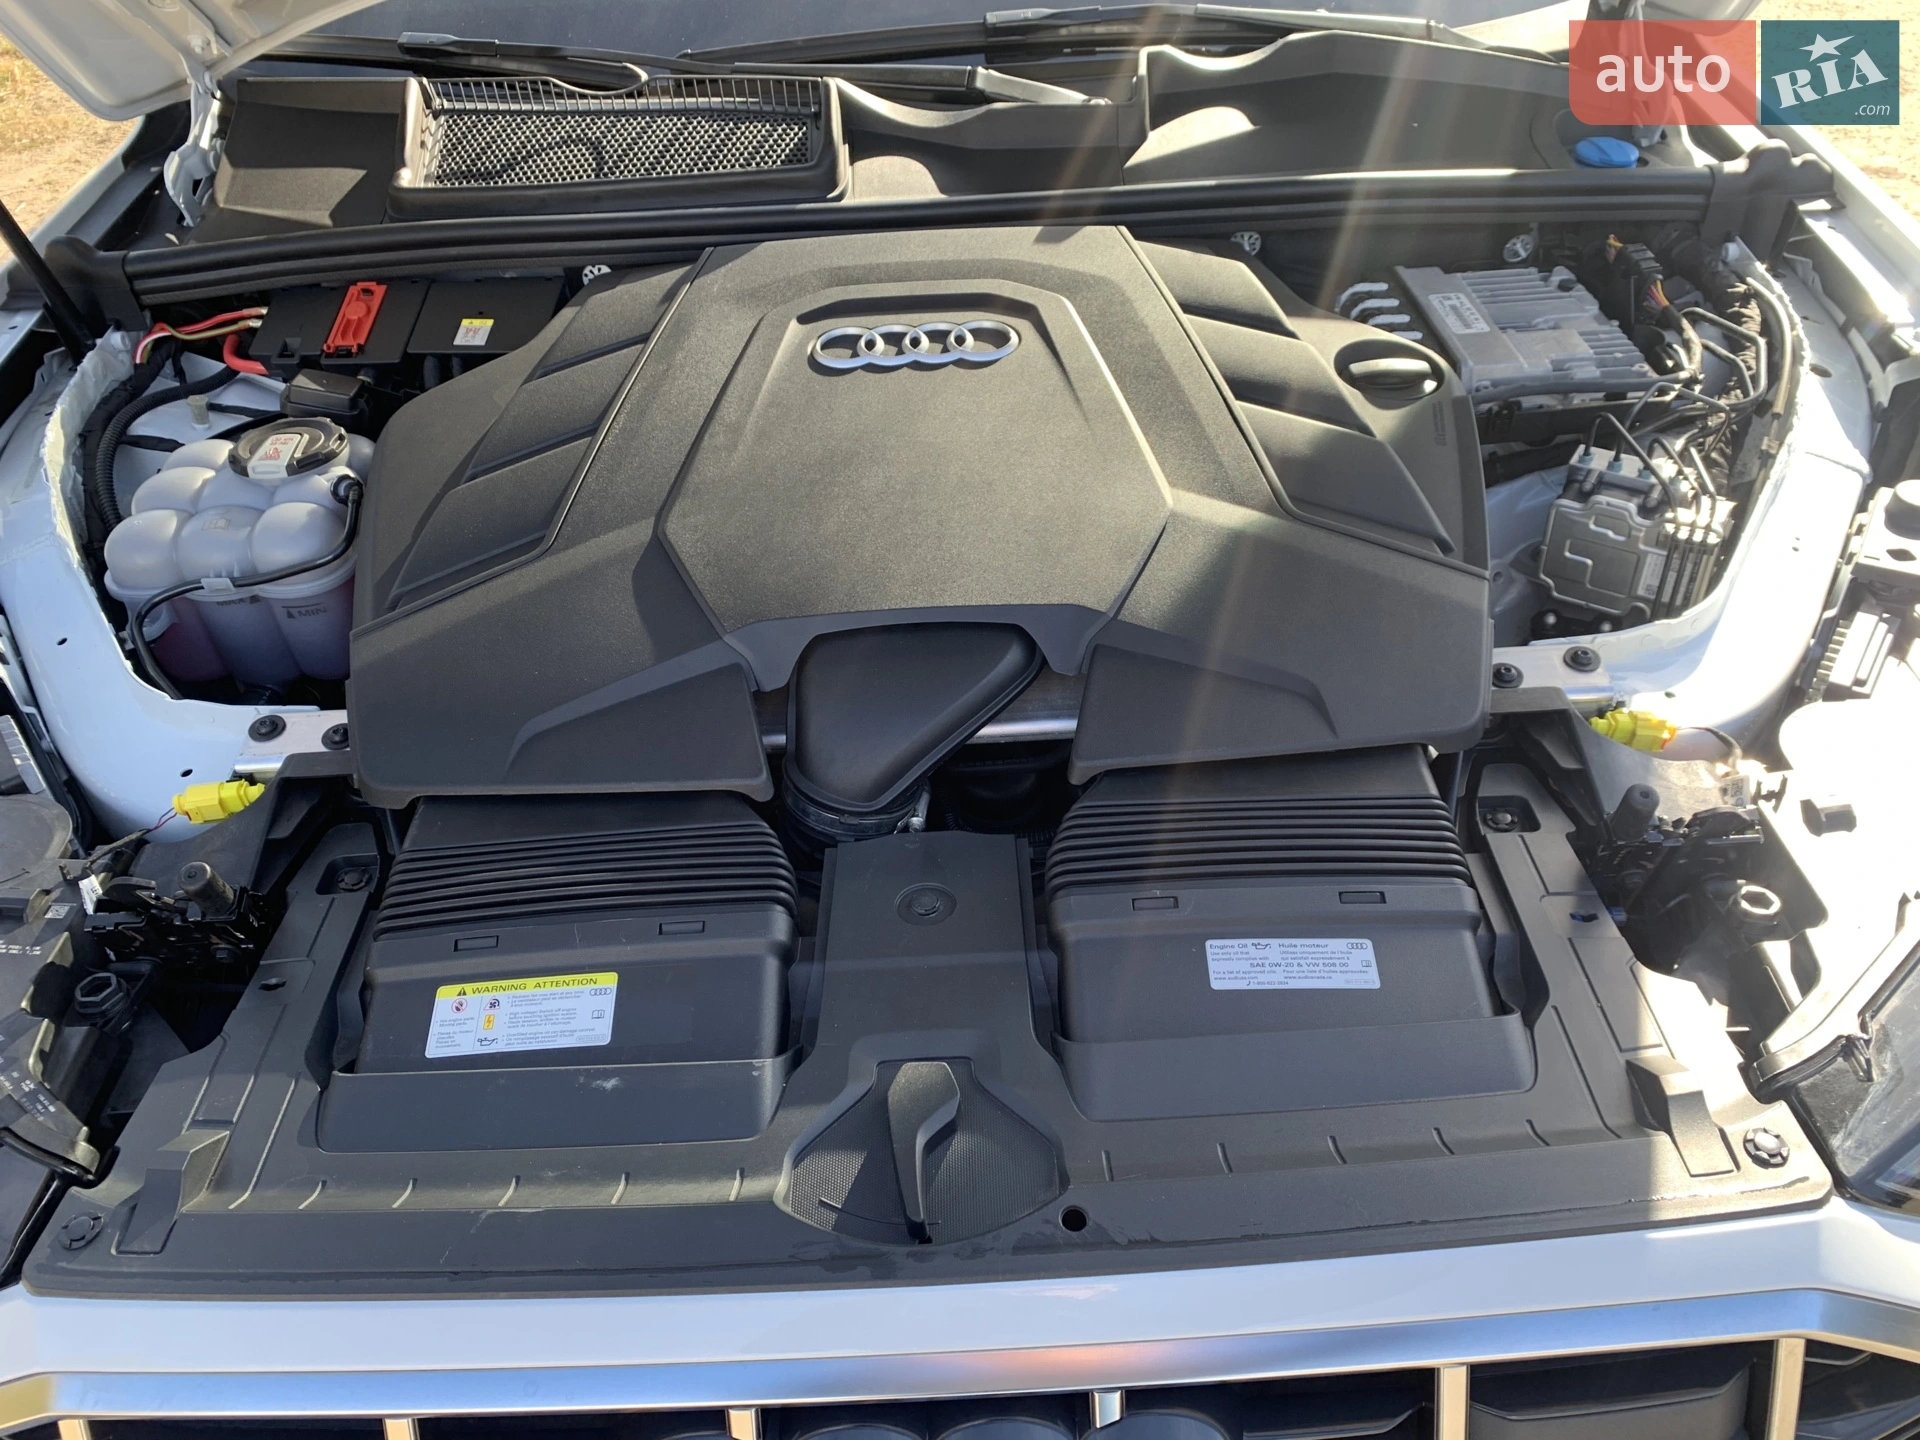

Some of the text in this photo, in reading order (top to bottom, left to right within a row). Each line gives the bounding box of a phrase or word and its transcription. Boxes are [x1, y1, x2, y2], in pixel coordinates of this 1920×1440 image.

[297, 607, 327, 617] MIN
[471, 977, 598, 994] WARNING ATTENTION
